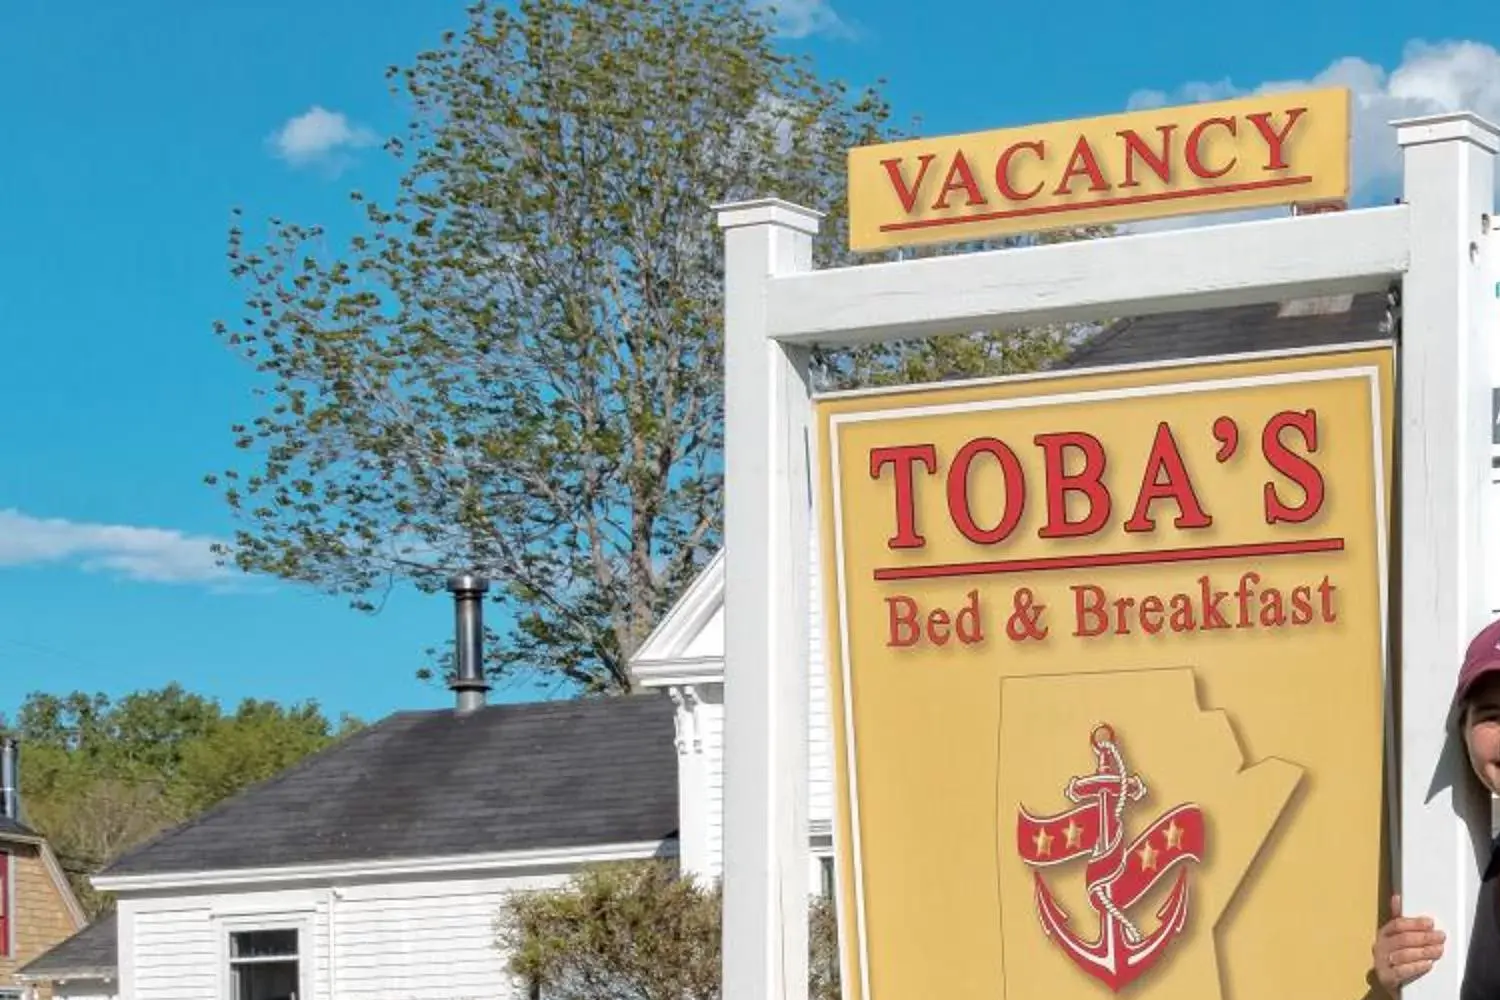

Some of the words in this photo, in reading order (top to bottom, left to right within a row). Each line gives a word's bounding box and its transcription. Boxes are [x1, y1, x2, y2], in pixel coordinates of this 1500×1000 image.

[880, 107, 1308, 214] VACANCY
[869, 408, 1326, 550] TOBA'S
[884, 588, 985, 648] Bed
[1006, 586, 1049, 643] &
[1069, 571, 1338, 638] Breakfast
